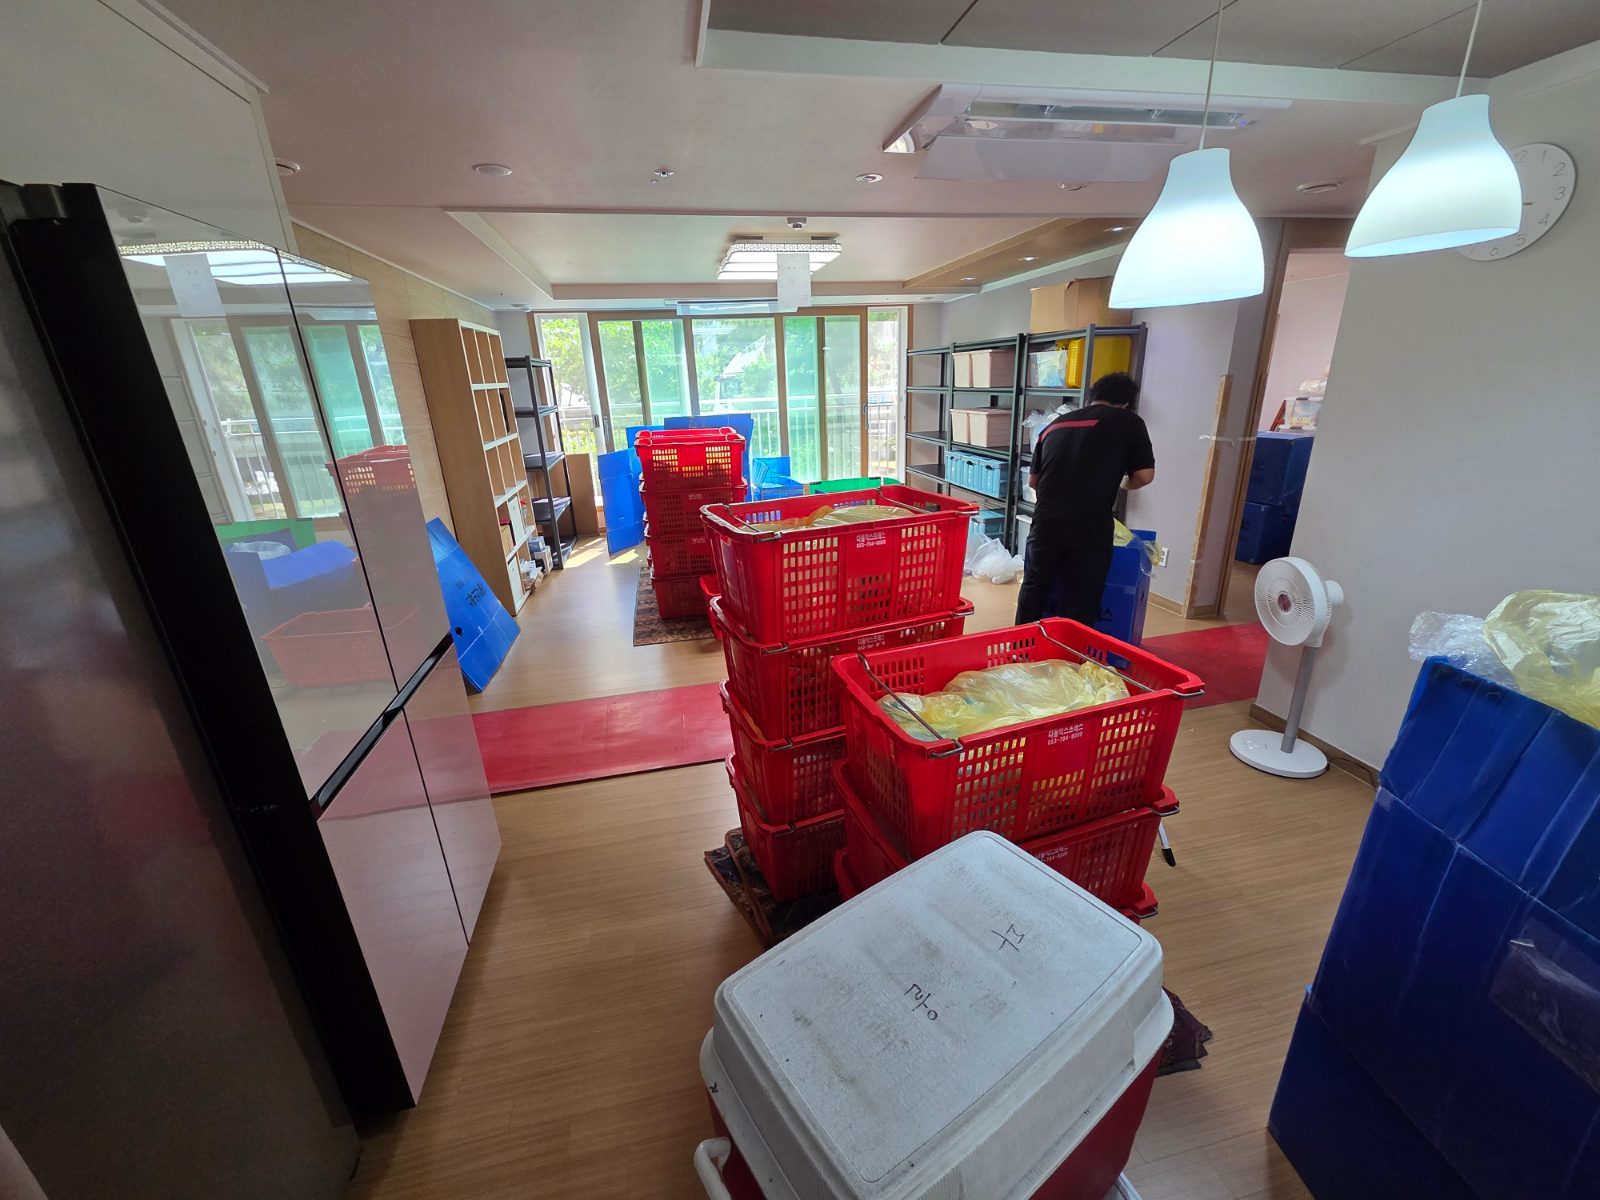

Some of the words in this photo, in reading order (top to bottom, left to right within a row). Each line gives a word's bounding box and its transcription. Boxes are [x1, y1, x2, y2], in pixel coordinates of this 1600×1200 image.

[1540, 149, 1548, 162] 1
[1552, 161, 1566, 177] 2
[1553, 185, 1567, 201] 3
[1537, 212, 1550, 226] 4
[1488, 243, 1500, 257] 6
